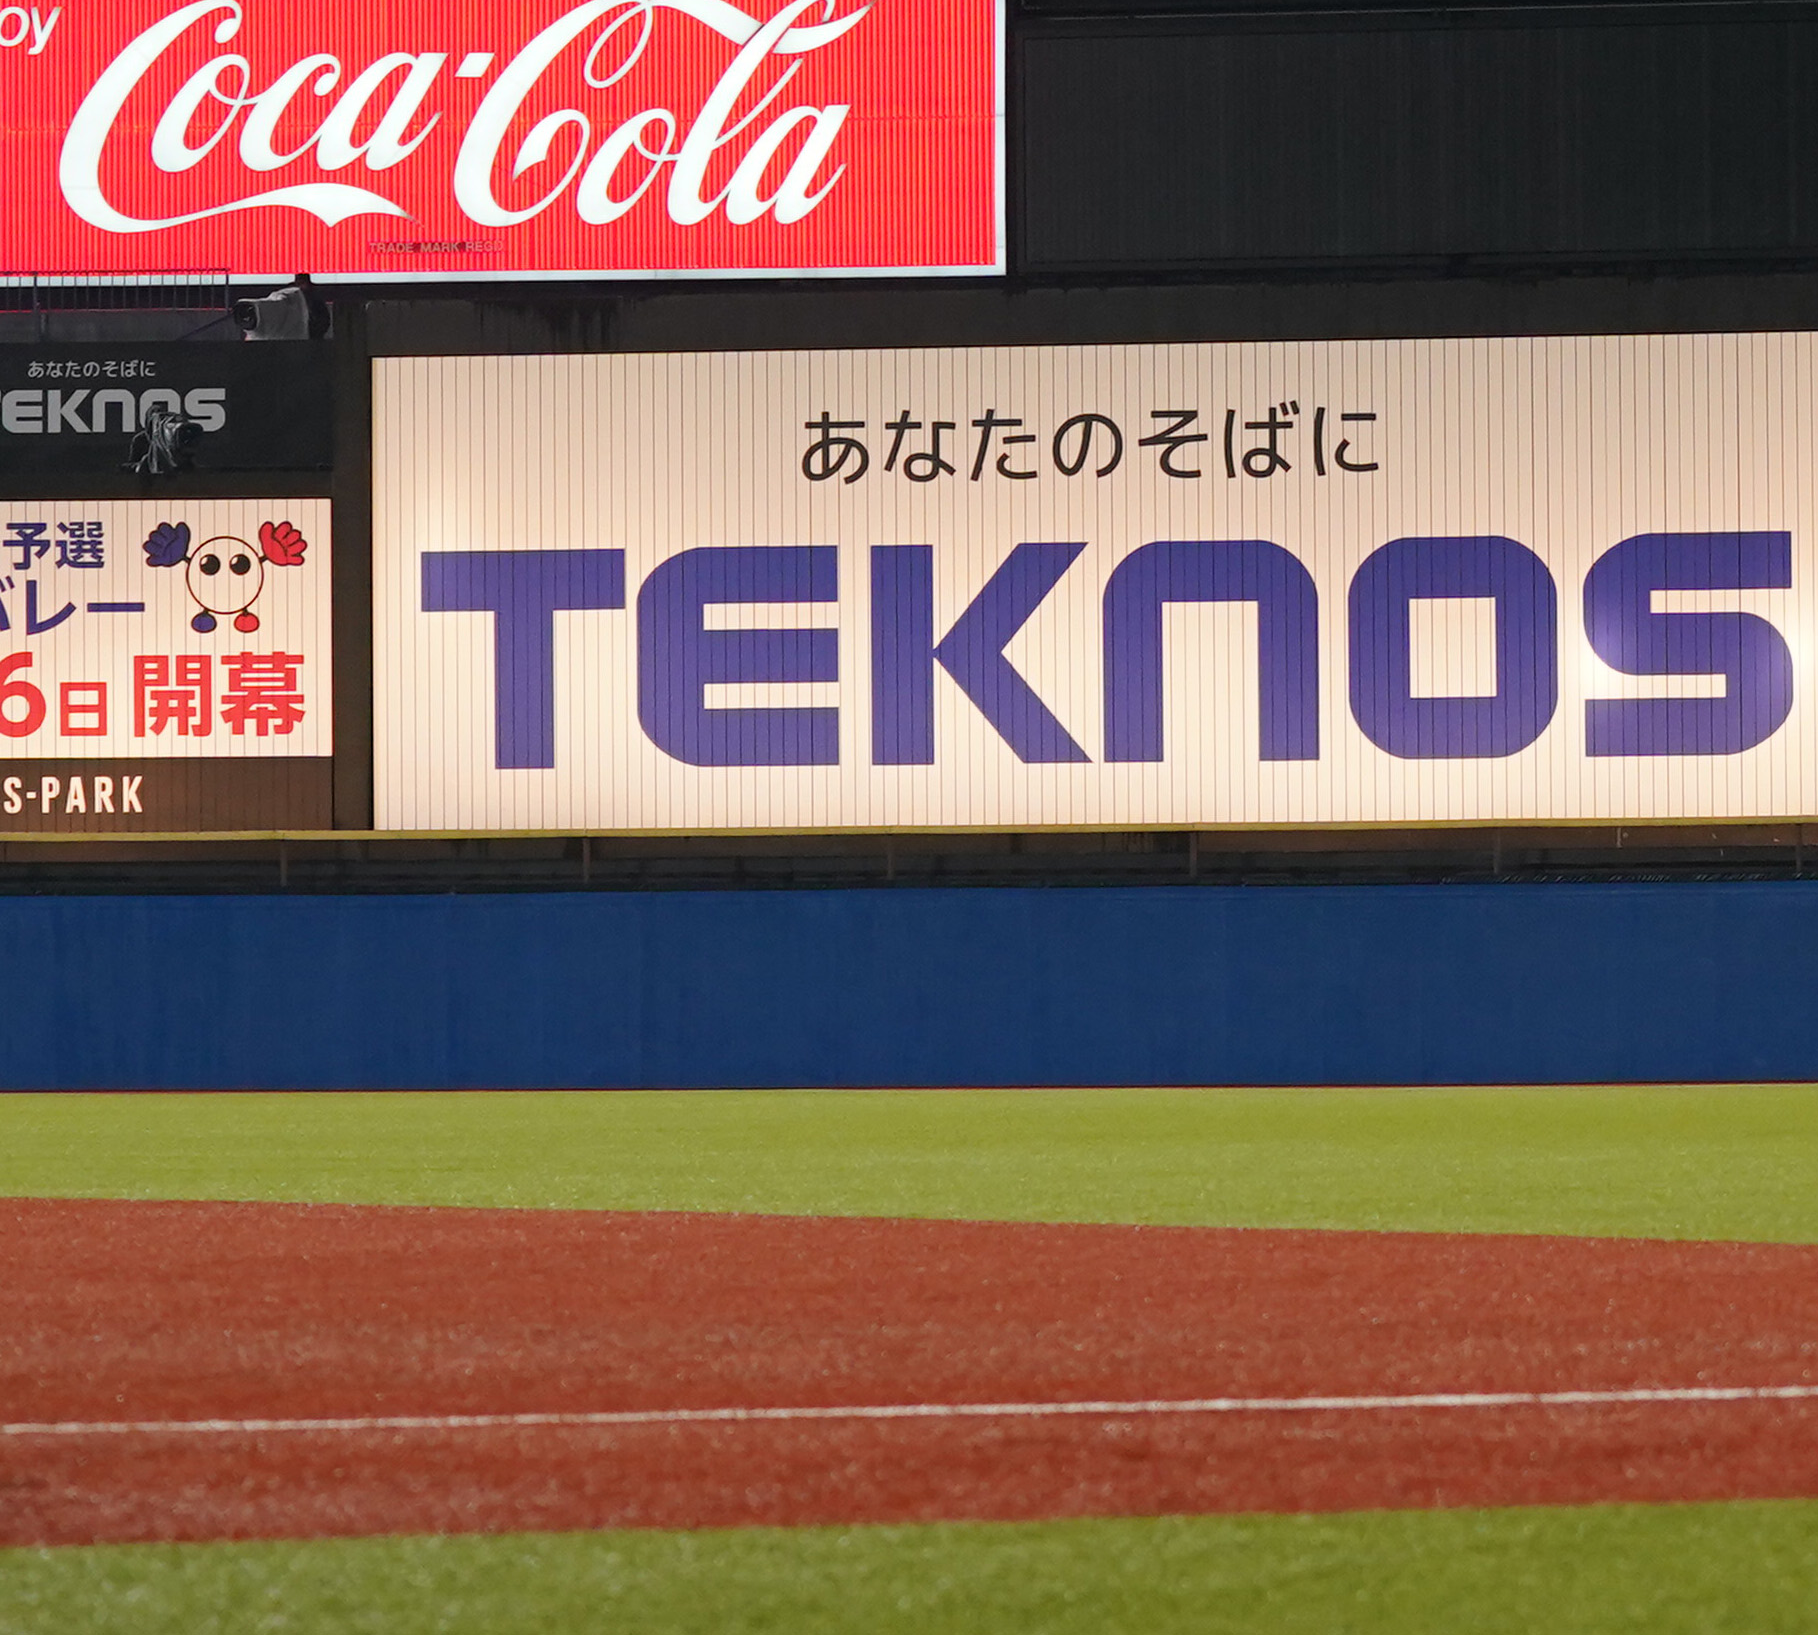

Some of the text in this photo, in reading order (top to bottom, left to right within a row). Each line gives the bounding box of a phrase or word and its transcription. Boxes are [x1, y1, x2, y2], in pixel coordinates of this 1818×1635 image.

[370, 243, 413, 253] TRADE
[420, 242, 461, 253] MARK
[28, 361, 155, 378] あなたのそばに
[801, 400, 1380, 485] あなたのそばに
[3, 521, 104, 570] 予選
[421, 531, 1794, 770] TEKNOS
